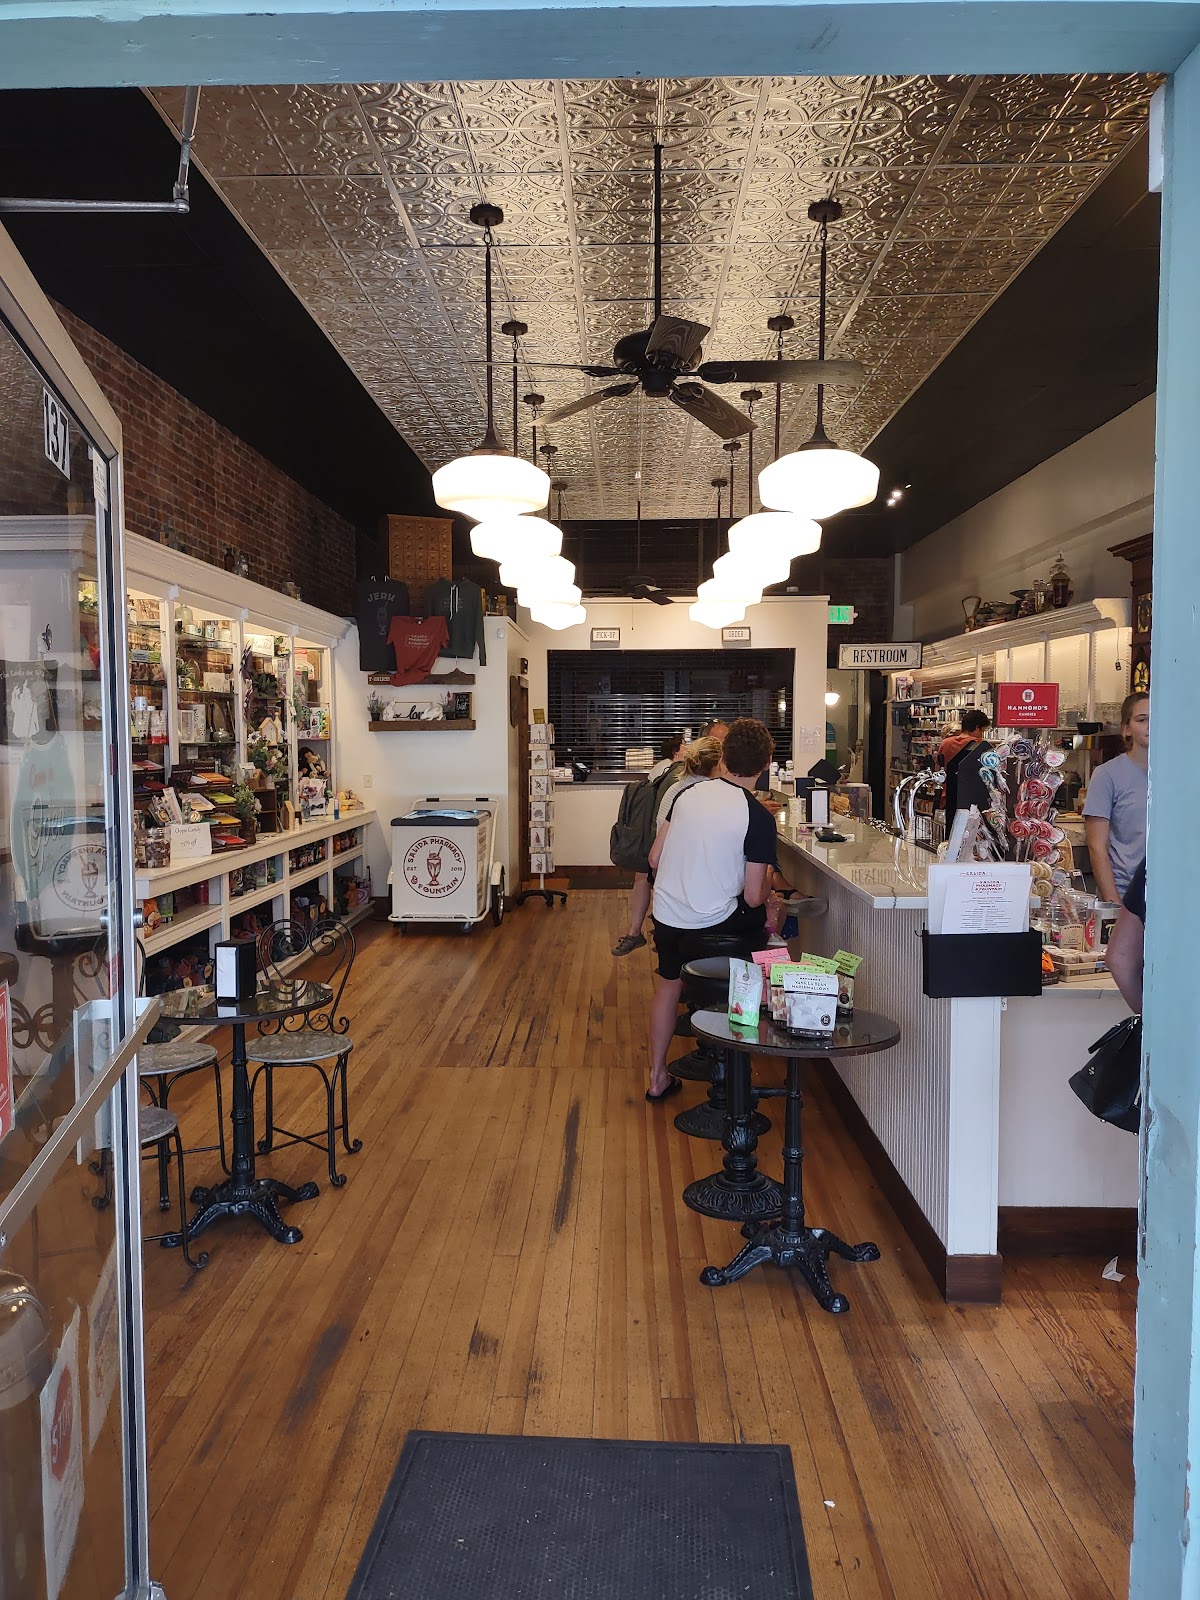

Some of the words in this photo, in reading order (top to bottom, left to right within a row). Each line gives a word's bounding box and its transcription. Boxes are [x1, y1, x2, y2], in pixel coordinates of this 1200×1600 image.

[44, 393, 68, 471] 137
[367, 592, 397, 603] JERK
[596, 631, 616, 639] PICK-UP
[728, 630, 744, 638] ORDER
[853, 649, 908, 663] RESTROOM
[408, 839, 429, 863] SALIDA
[430, 838, 462, 863] PHARMACY
[411, 875, 418, 885] &
[417, 877, 459, 895] FOUNTAIN
